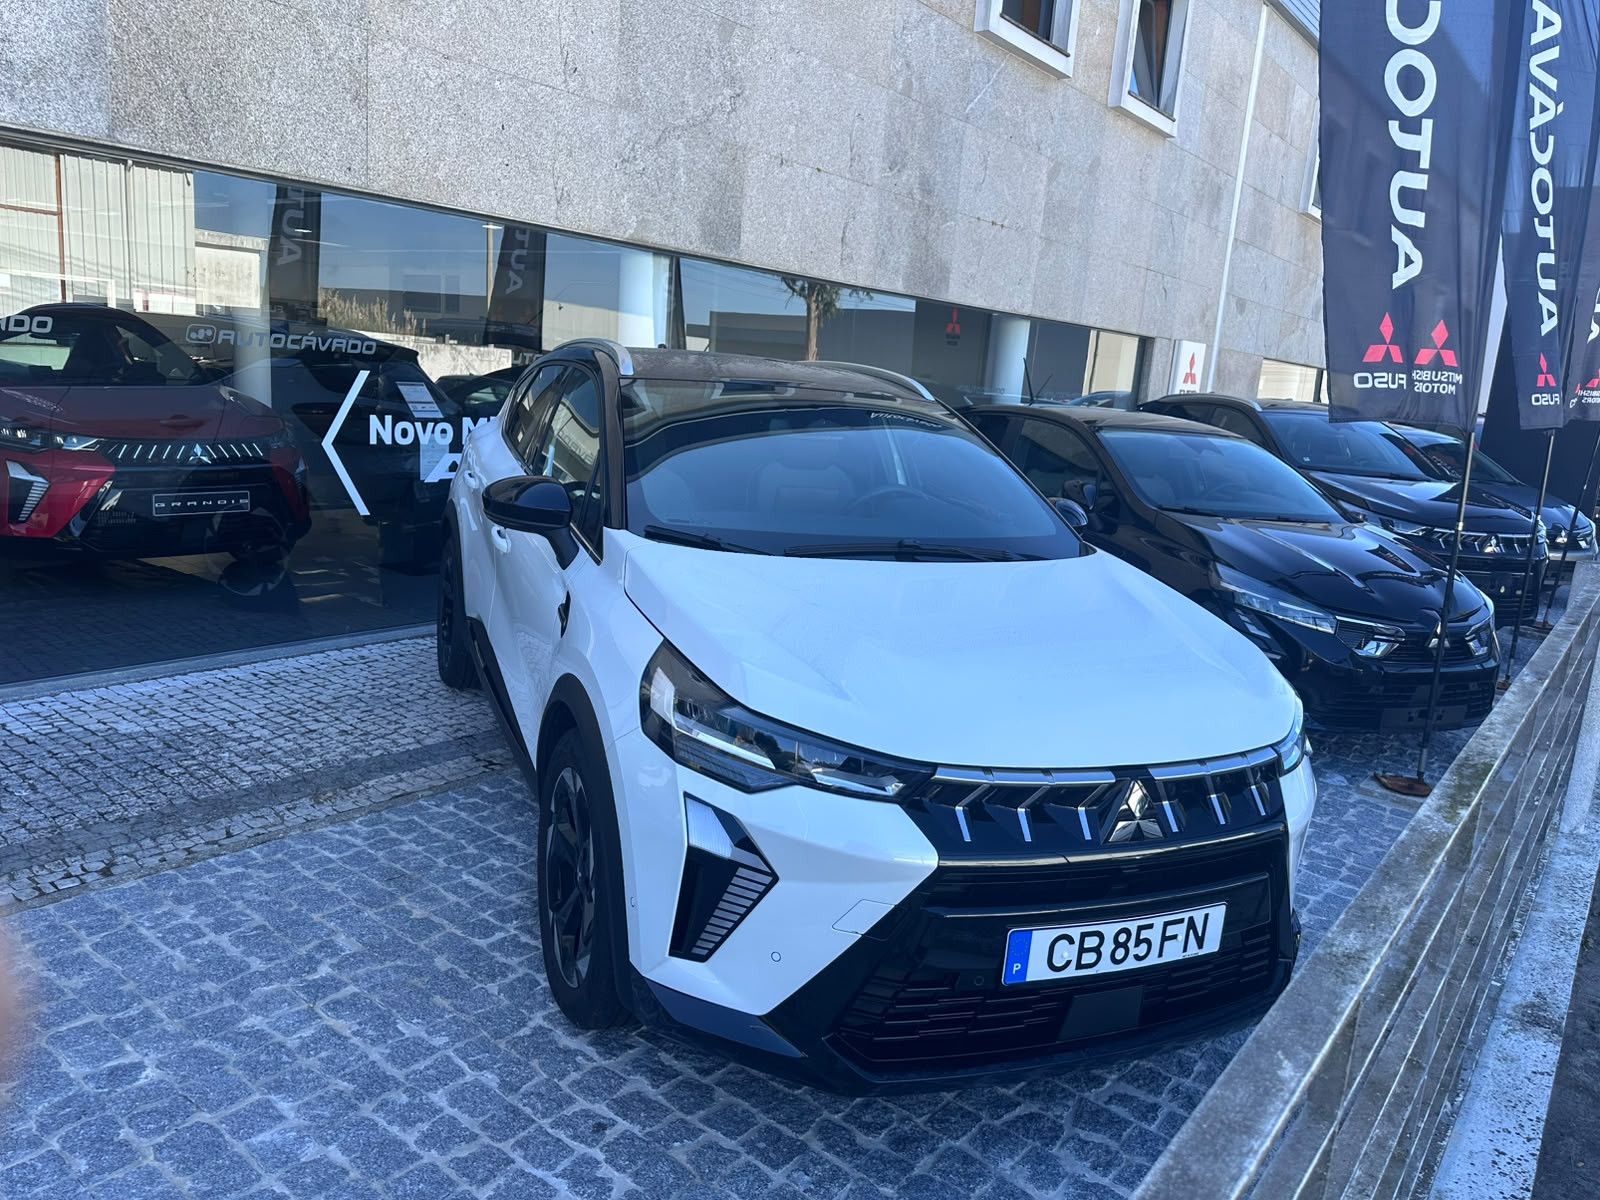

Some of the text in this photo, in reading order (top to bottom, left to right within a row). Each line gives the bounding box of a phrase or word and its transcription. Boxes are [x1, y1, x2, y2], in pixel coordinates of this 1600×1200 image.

[218, 329, 376, 355] AUTOCÁVADO
[369, 414, 454, 446] Novo
[155, 499, 249, 508] GRANDIS
[1012, 963, 1022, 975] P
